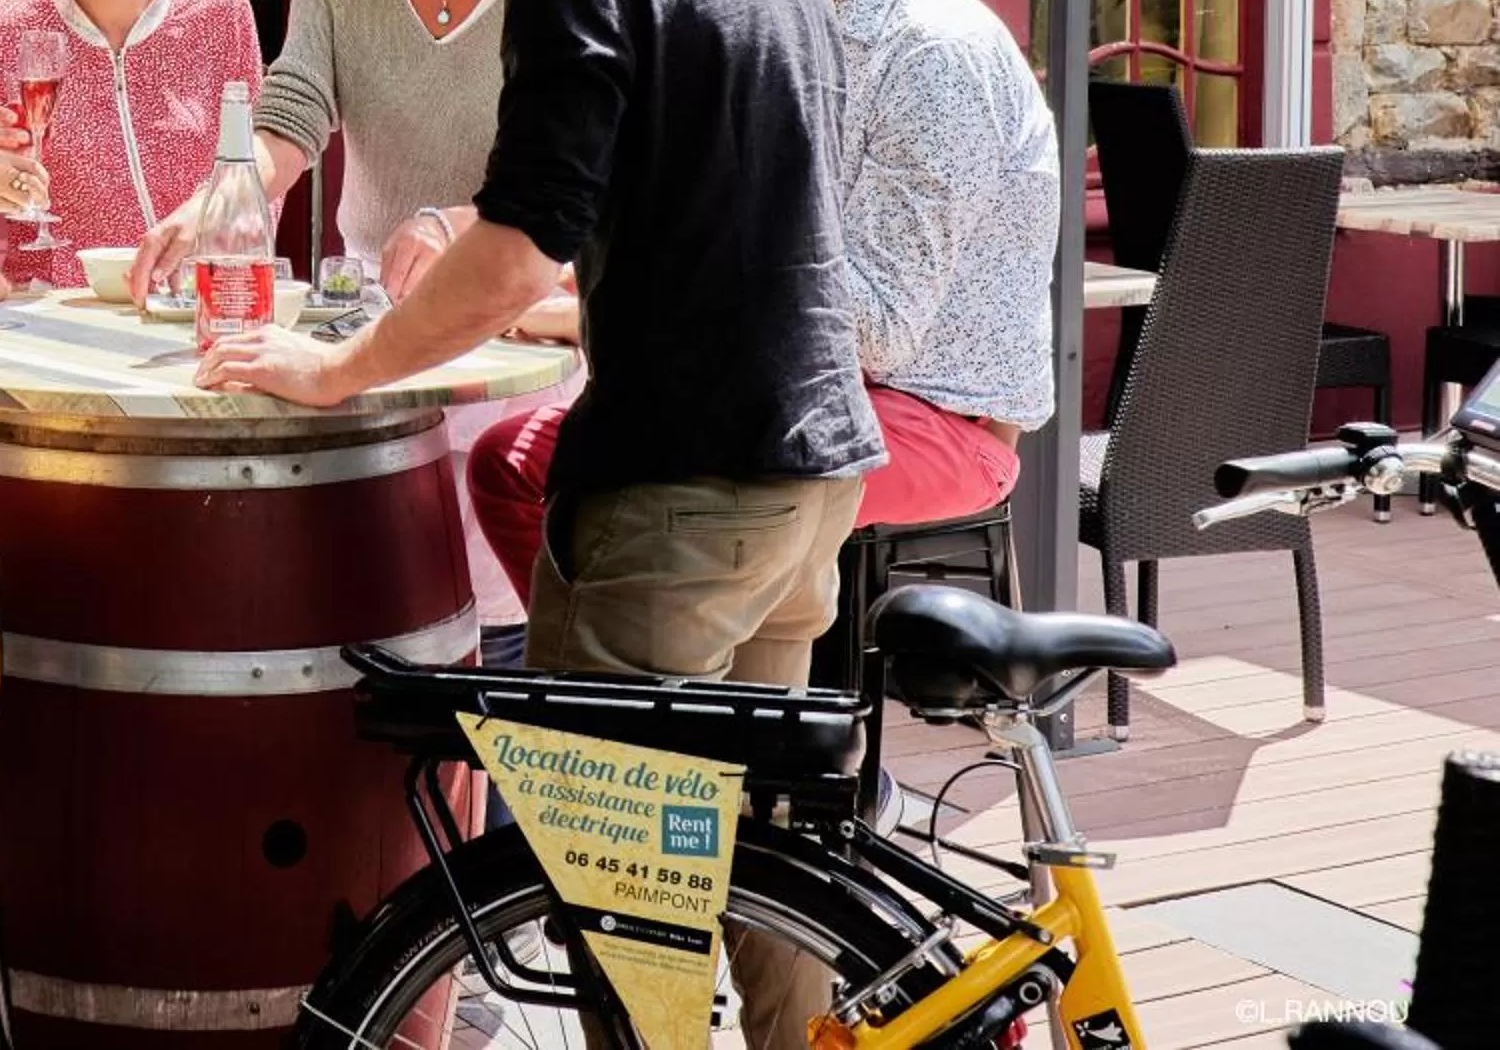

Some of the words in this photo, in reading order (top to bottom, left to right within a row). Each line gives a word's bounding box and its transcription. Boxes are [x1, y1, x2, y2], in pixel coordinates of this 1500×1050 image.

[493, 735, 618, 783] Location
[624, 763, 659, 791] de
[665, 768, 720, 801] vélo
[518, 774, 534, 795] à
[539, 780, 657, 818] assistance
[538, 804, 650, 845] électrique
[667, 813, 713, 834] Rent
[565, 850, 590, 867] 06
[595, 856, 621, 873] 45
[626, 862, 649, 879] 41
[656, 868, 682, 885] 59
[687, 874, 713, 891] 88
[614, 881, 711, 914] PAIMPONT
